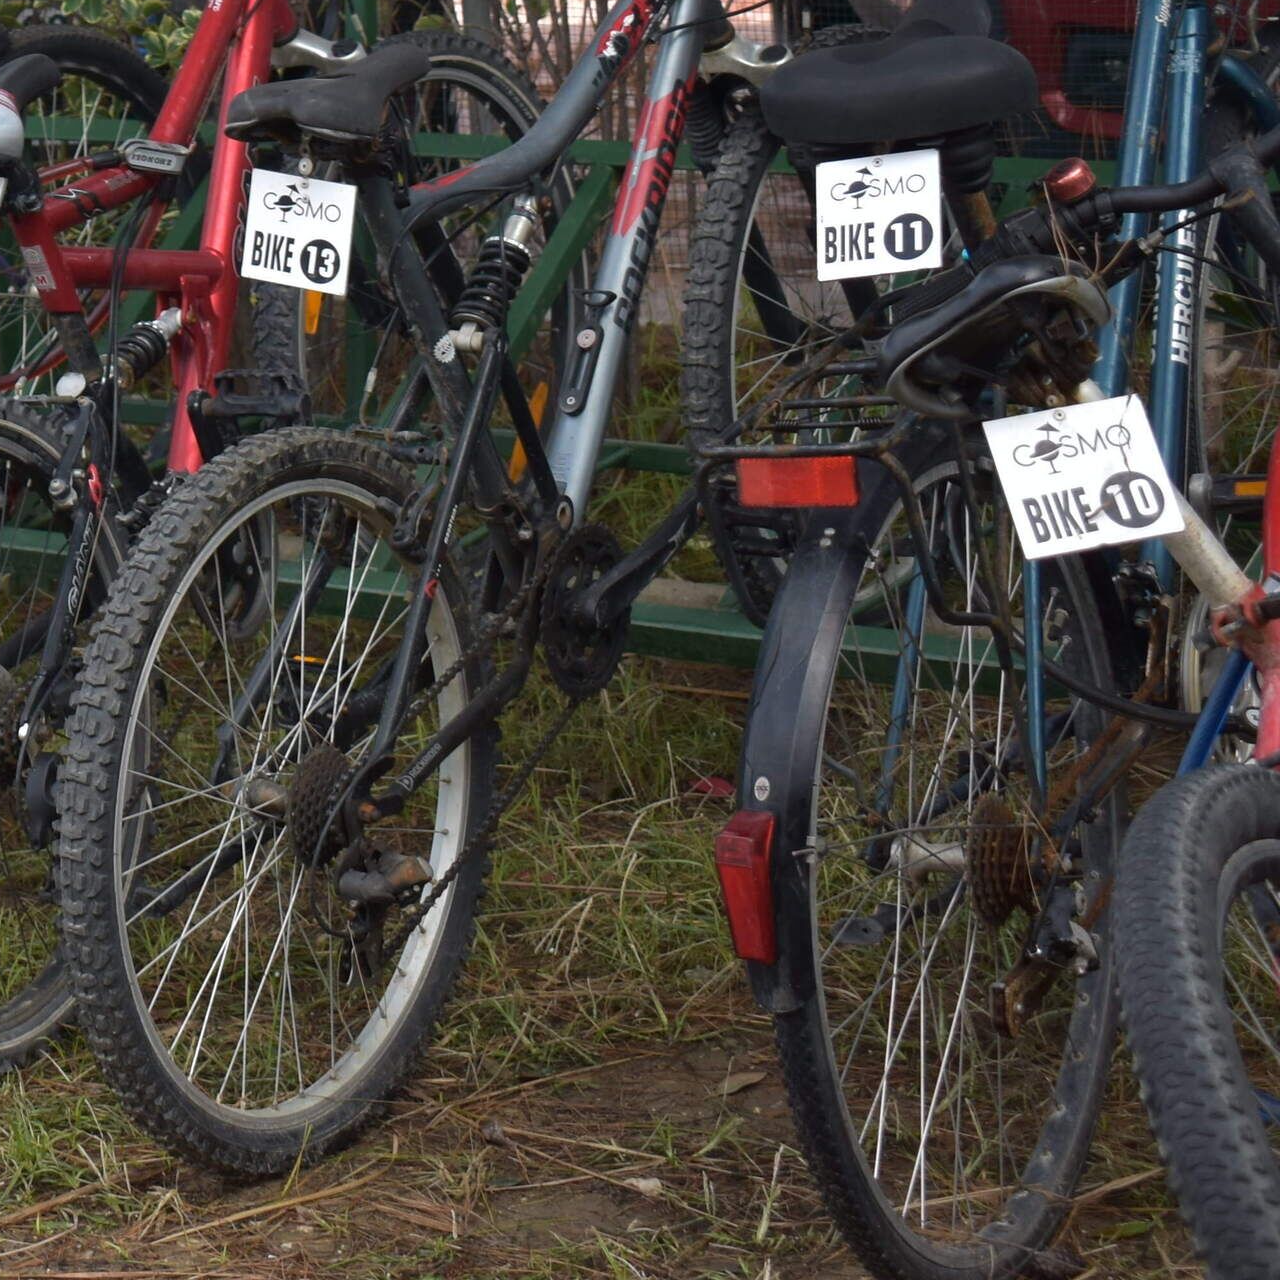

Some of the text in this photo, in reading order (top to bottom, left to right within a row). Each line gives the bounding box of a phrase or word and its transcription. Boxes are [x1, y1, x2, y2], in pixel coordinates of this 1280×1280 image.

[251, 230, 336, 279] BIKE 13
[824, 220, 923, 265] BIKE 11
[1171, 208, 1197, 366] HERCULES
[1022, 478, 1160, 544] BIKE 10
